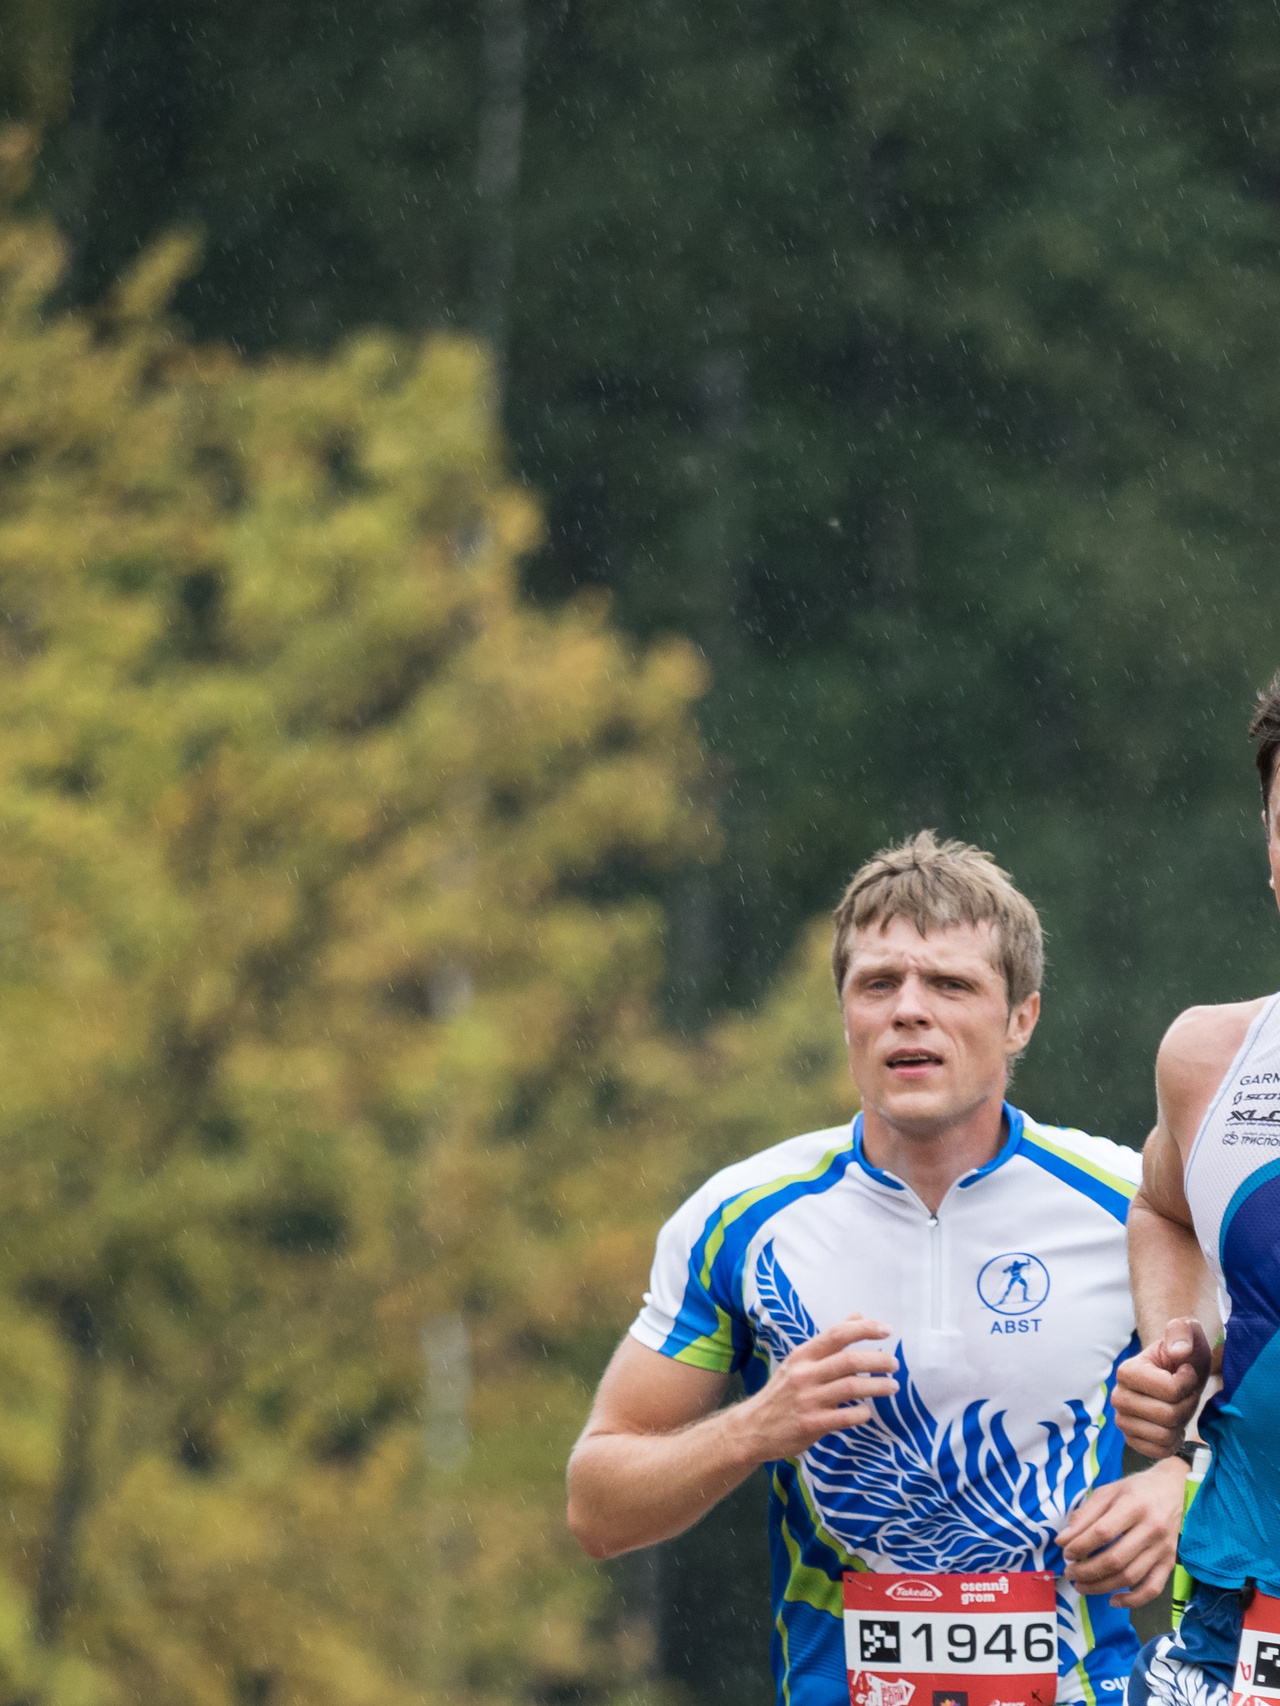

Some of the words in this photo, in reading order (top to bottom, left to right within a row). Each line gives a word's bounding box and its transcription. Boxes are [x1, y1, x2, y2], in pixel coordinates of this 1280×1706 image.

[990, 1318, 1043, 1335] ABST
[896, 1587, 934, 1597] Takeda
[960, 1593, 996, 1605] grom
[912, 1623, 1054, 1664] 1946
